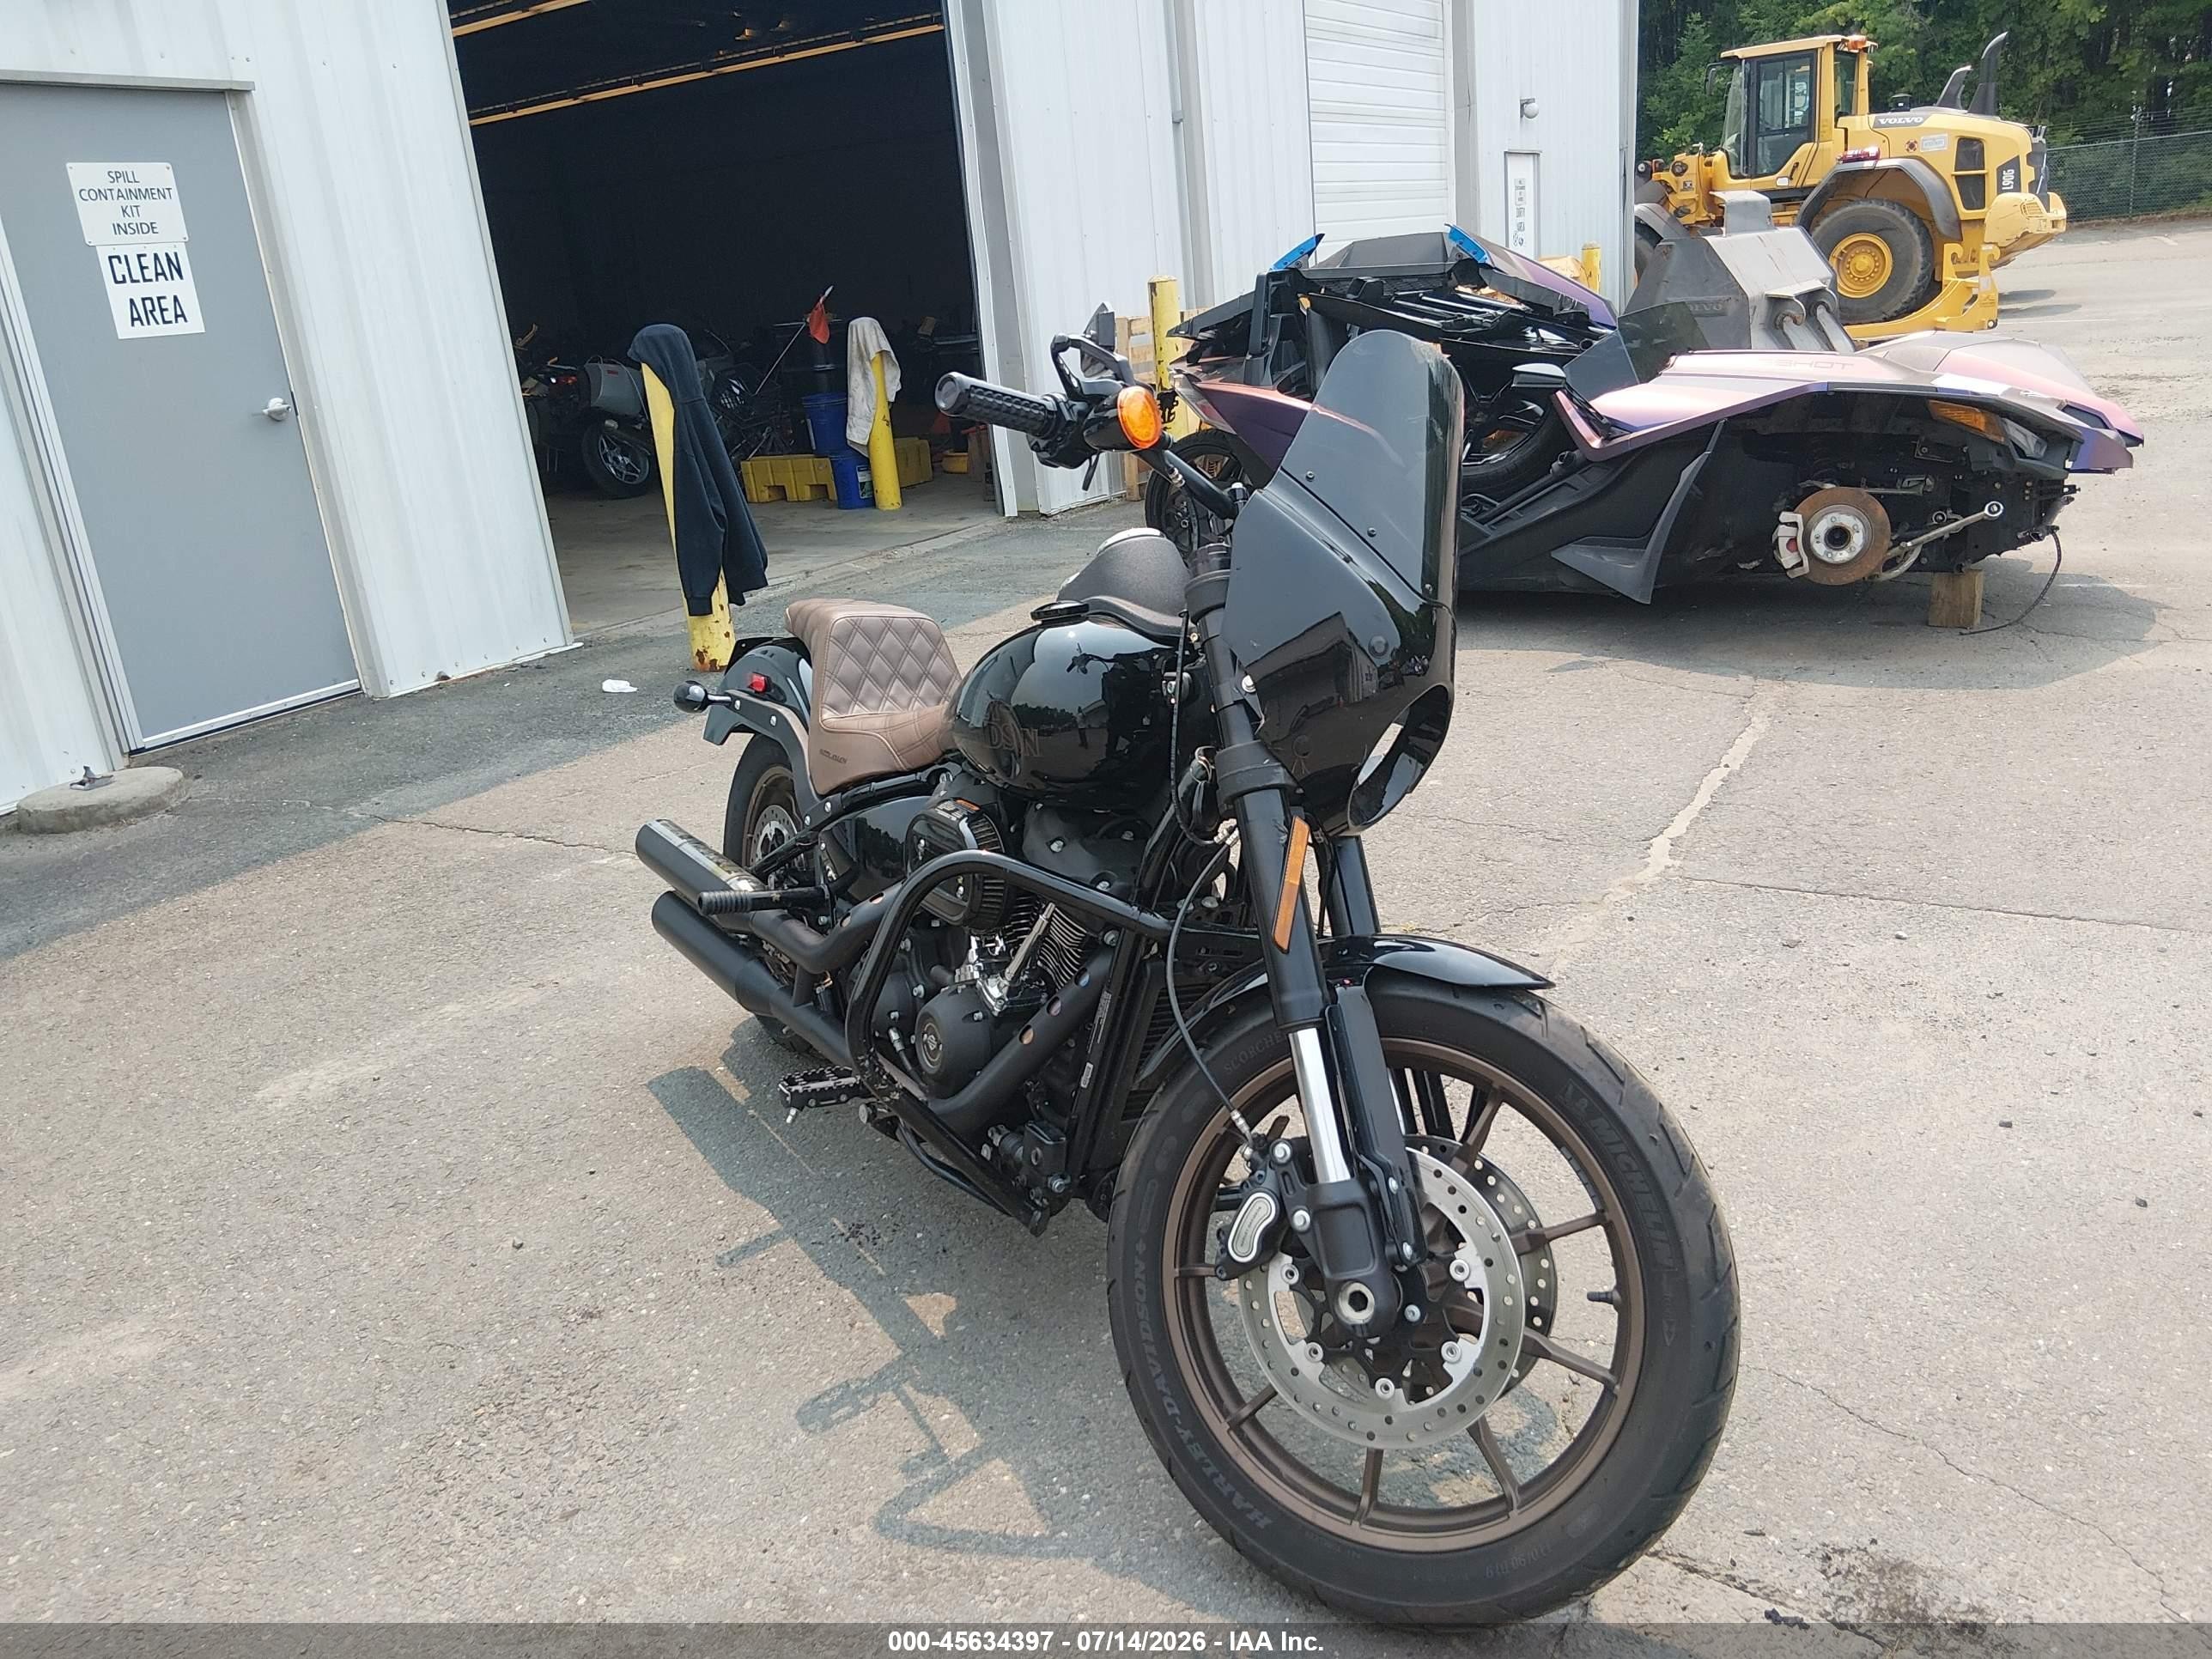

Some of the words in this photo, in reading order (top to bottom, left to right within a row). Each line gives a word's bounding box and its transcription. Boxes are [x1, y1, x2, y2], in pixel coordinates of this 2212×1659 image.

[1877, 116, 1924, 125] VOLVO
[106, 170, 141, 185] SPILL
[2002, 168, 2015, 191] L90G
[78, 186, 173, 202] CONTAINMENT
[120, 204, 141, 218] KIT
[112, 222, 160, 236] INSIDE
[107, 251, 185, 285] CLEAN
[129, 295, 188, 327] AREA
